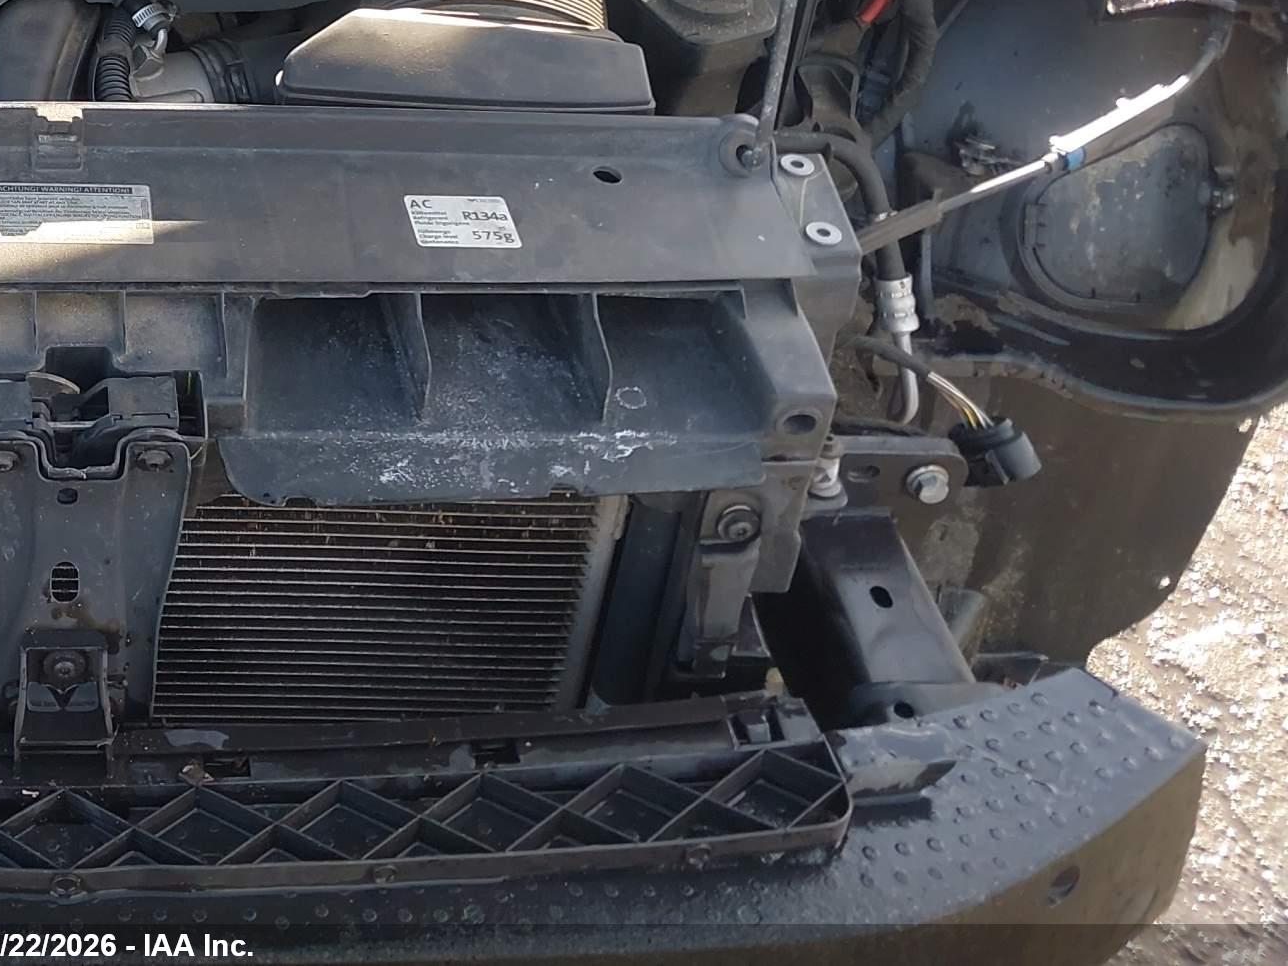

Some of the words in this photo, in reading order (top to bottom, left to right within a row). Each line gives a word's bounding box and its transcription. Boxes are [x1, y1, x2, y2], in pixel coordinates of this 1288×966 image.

[83, 186, 130, 194] ATTENTION!
[410, 199, 433, 209] AC
[462, 210, 509, 221] R134a
[471, 230, 515, 244] 575g
